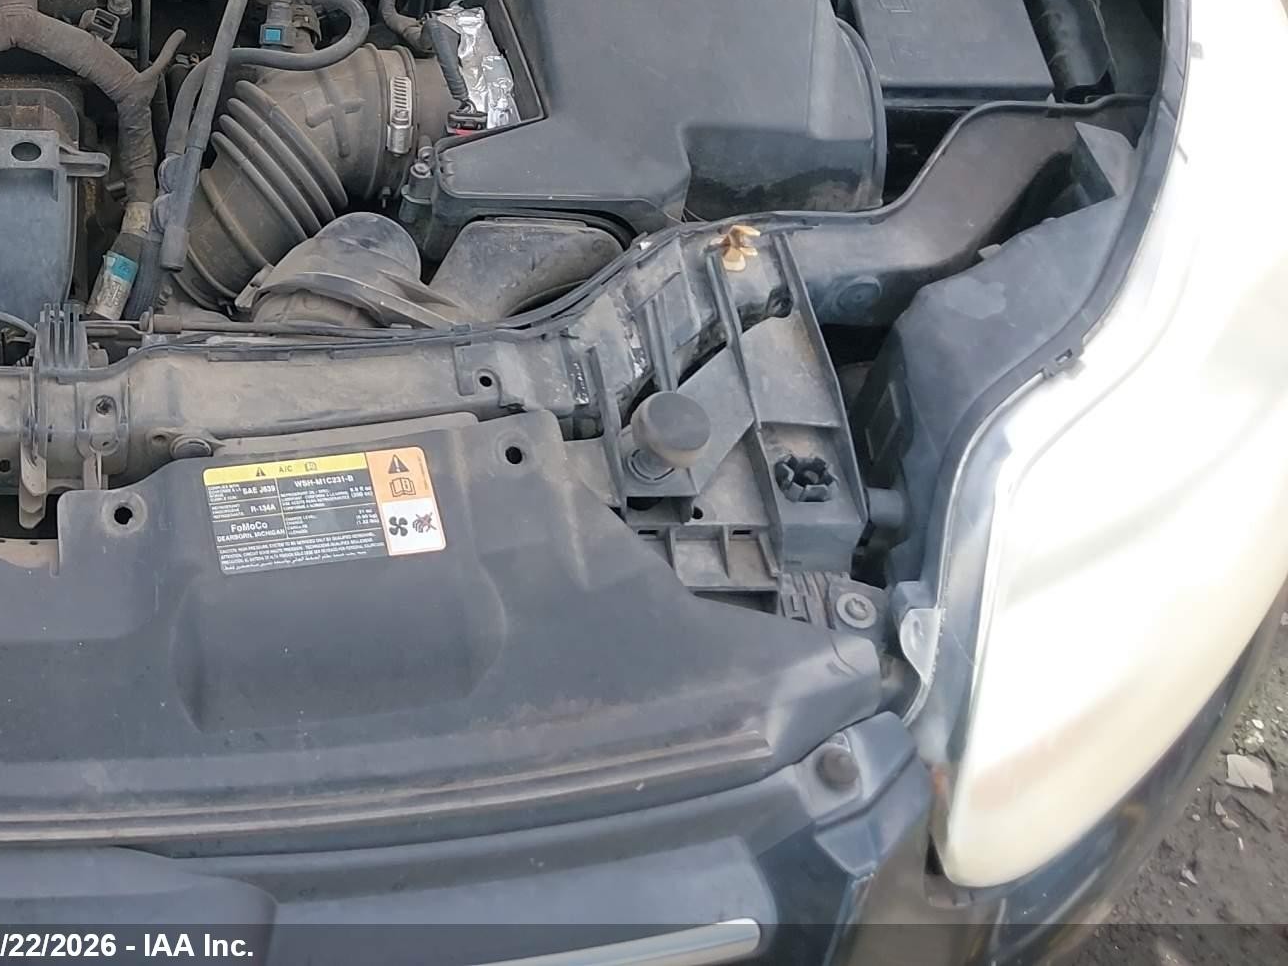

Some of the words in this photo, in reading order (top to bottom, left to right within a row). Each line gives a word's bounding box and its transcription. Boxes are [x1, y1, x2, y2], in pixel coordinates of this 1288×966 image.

[279, 465, 293, 473] A/C
[242, 486, 258, 495] SAE
[250, 504, 277, 513] R-134A
[230, 521, 268, 532] FoMoCo
[254, 528, 286, 538] MICHIGAN
